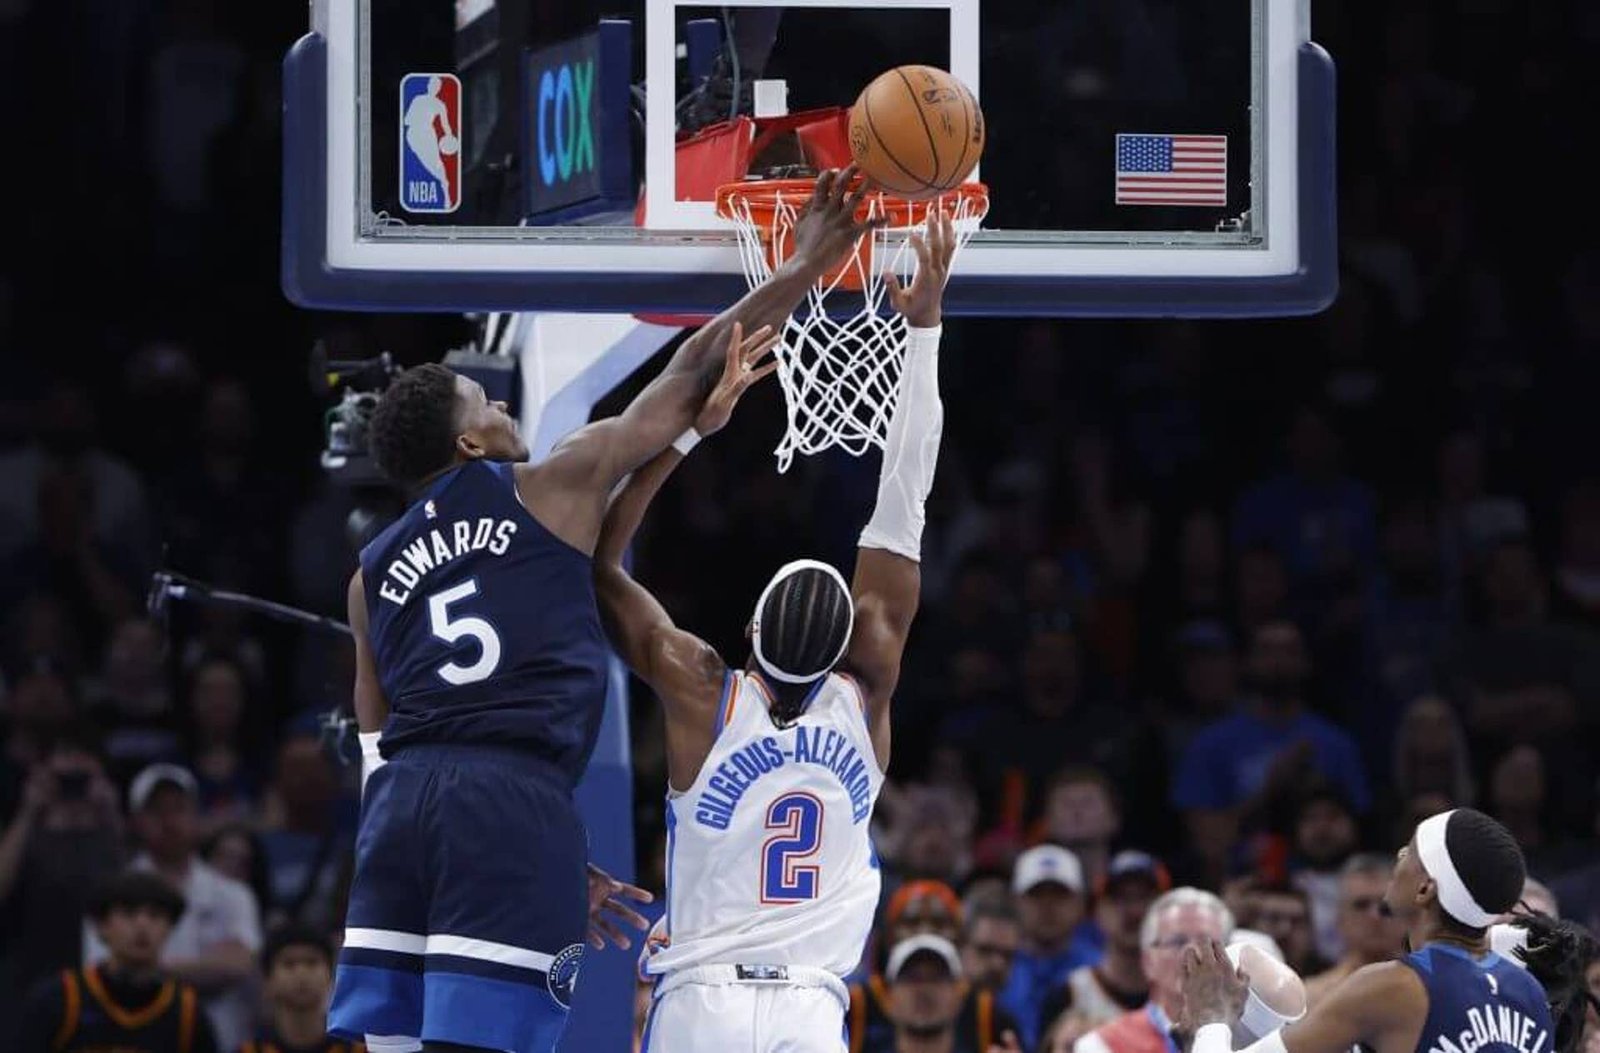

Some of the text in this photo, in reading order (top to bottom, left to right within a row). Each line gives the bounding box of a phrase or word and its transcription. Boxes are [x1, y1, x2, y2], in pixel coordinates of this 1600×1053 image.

[538, 60, 594, 186] COX
[409, 181, 438, 203] NBA
[379, 517, 518, 606] EDWARDS
[428, 579, 501, 686] 5
[696, 726, 870, 831] GILGEOUS-ALEXANDER
[760, 791, 824, 904] 2
[1429, 1004, 1556, 1053] McDANIEL
